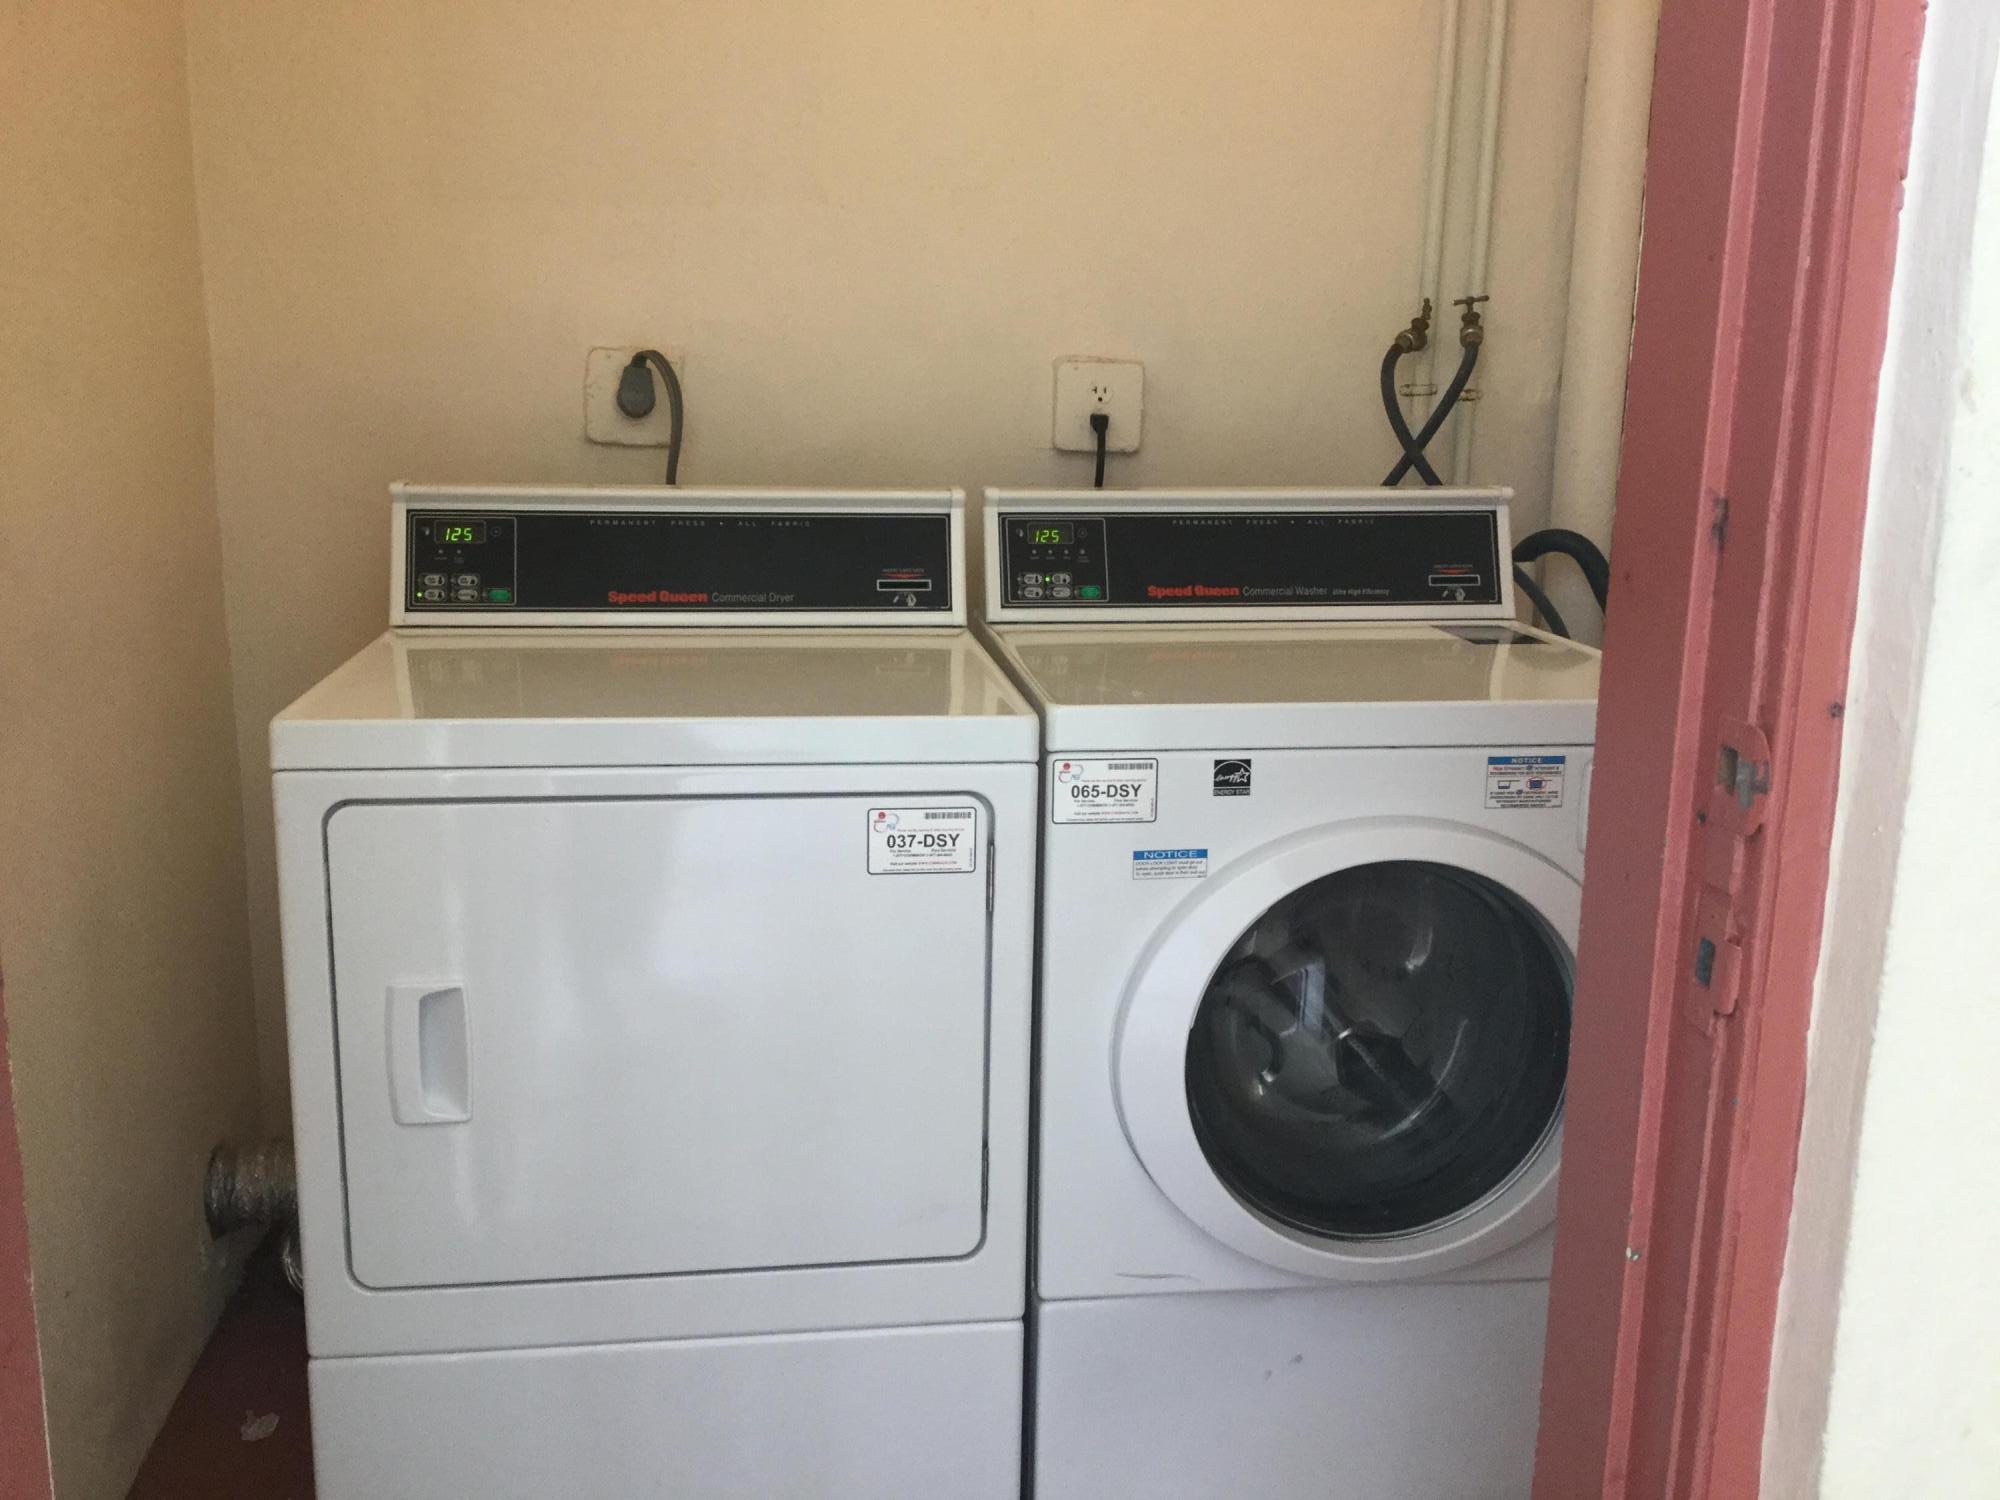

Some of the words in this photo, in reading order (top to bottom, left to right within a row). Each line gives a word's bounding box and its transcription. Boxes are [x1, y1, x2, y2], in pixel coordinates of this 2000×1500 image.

[445, 527, 473, 541] 125
[1034, 530, 1061, 543] 125
[607, 590, 657, 604] Speed
[659, 590, 709, 603] Queen
[711, 591, 767, 602] Commercial
[769, 592, 795, 604] Dryer
[1147, 585, 1193, 599] Speed
[1194, 585, 1240, 597] Queen
[1242, 586, 1293, 596] Commercial
[1295, 585, 1328, 596] Washer
[1071, 784, 1142, 798] 065-DSY
[886, 833, 961, 848] 037-DSY
[1143, 850, 1198, 859] NOTICE
